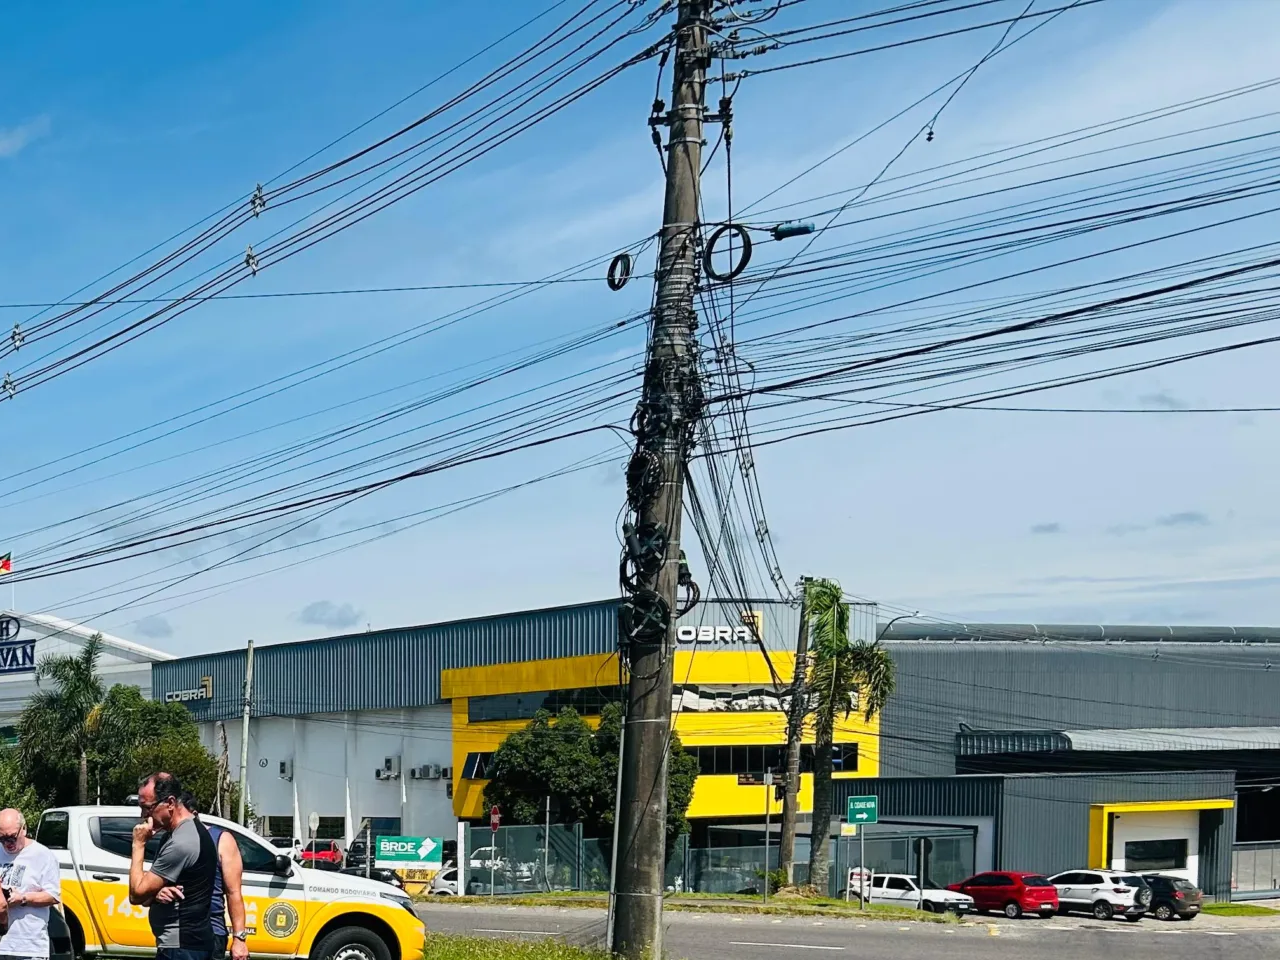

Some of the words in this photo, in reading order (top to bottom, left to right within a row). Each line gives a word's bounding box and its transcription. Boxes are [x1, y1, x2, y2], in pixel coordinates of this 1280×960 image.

[677, 626, 756, 641] OBRA
[165, 687, 206, 703] COBRA
[380, 841, 416, 852] BRDE
[308, 885, 339, 894] COMANDO
